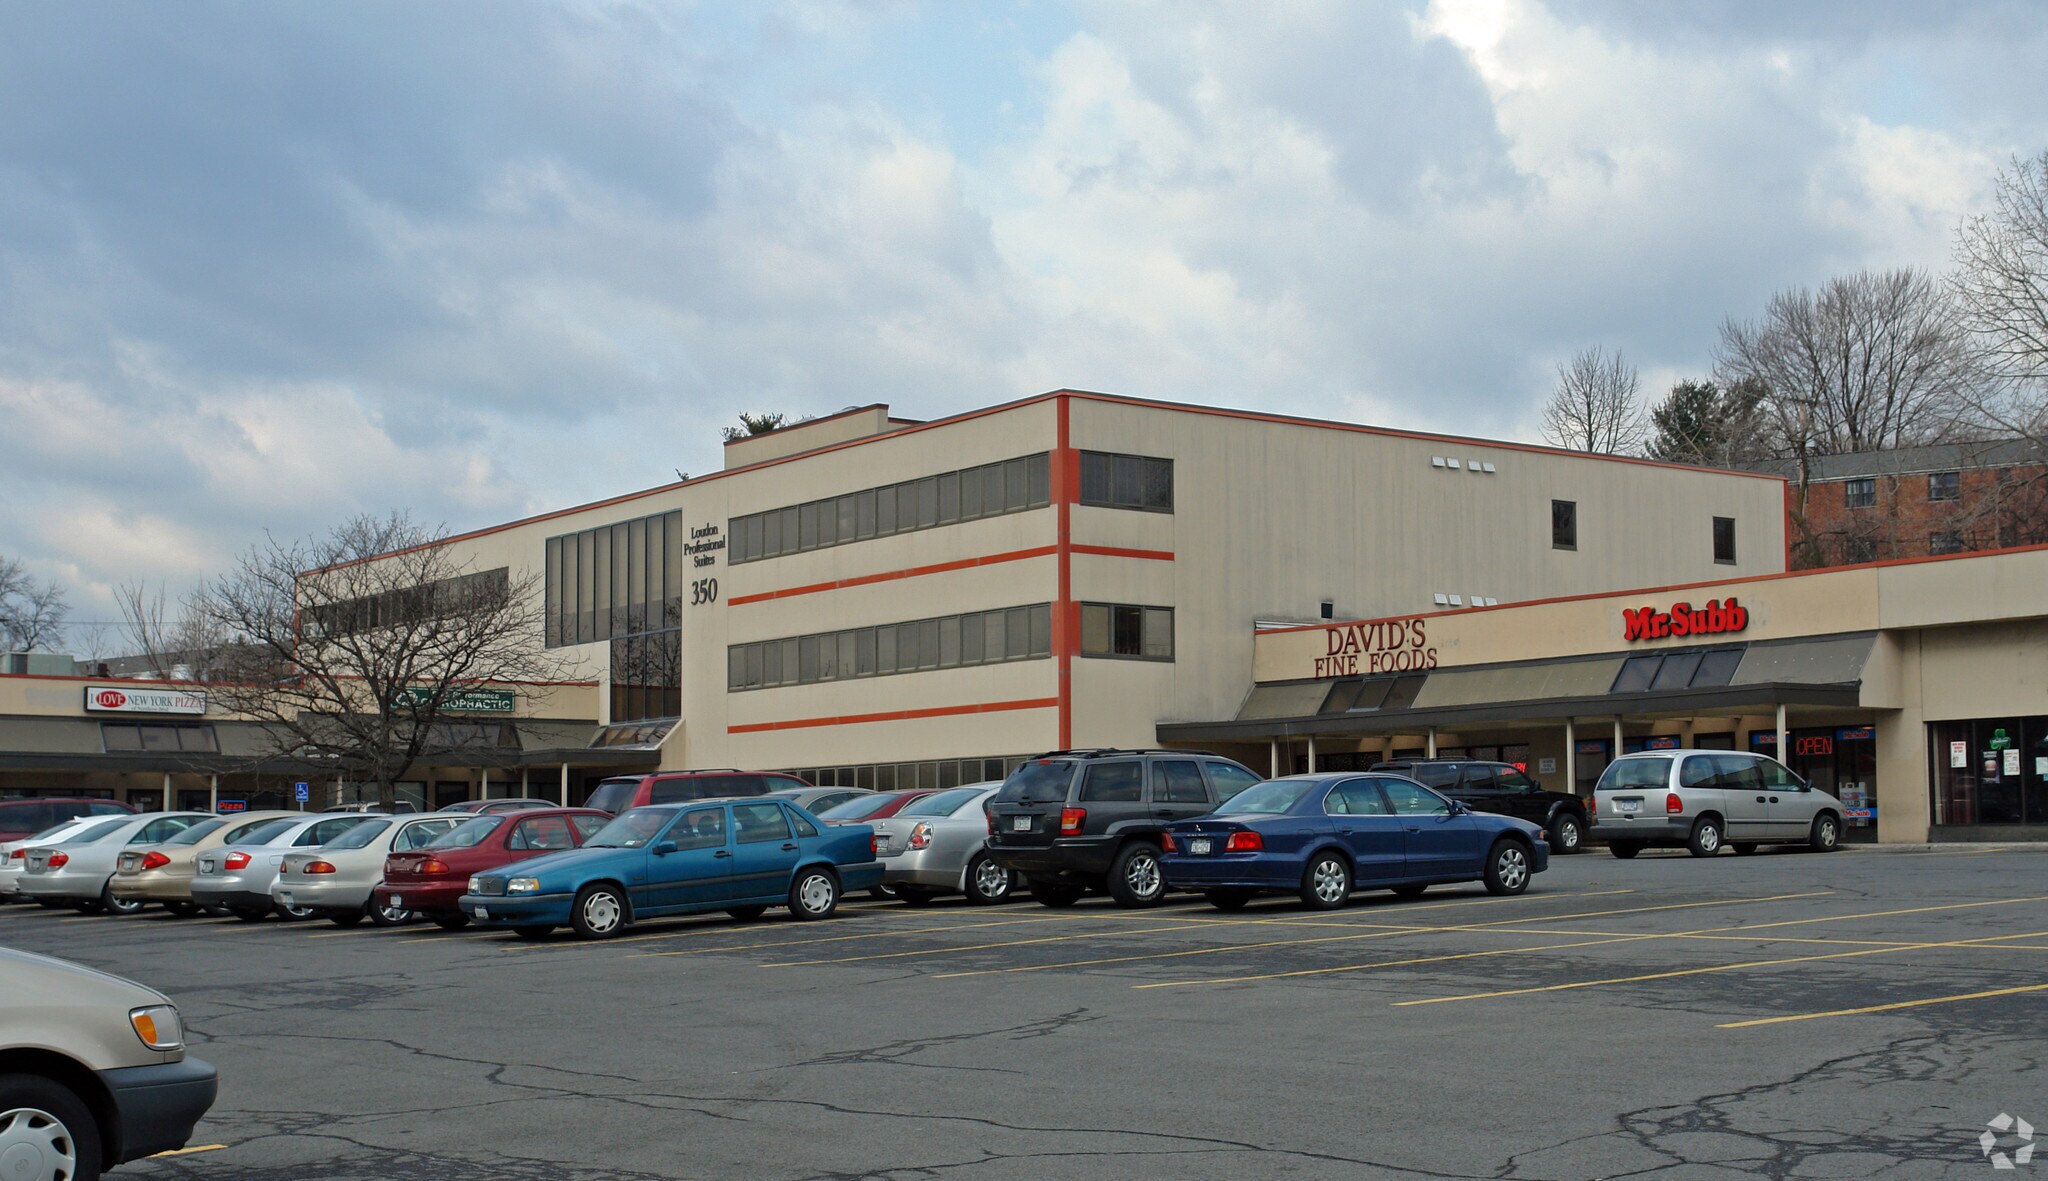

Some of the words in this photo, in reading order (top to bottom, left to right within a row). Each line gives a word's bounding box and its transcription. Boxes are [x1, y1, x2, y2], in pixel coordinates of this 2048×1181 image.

[691, 522, 718, 539] Loudon
[684, 534, 726, 556] Professional
[693, 554, 715, 568] Suites
[691, 577, 718, 606] 350
[1326, 618, 1426, 656] DAVID'S
[1314, 654, 1359, 680] FINE
[1369, 648, 1438, 675] FOODS
[90, 693, 94, 704] I
[99, 693, 124, 705] LOVE
[127, 695, 151, 706] NEW
[150, 696, 173, 707] YORK
[1796, 736, 1833, 755] OPEN
[219, 801, 244, 810] Pizza
